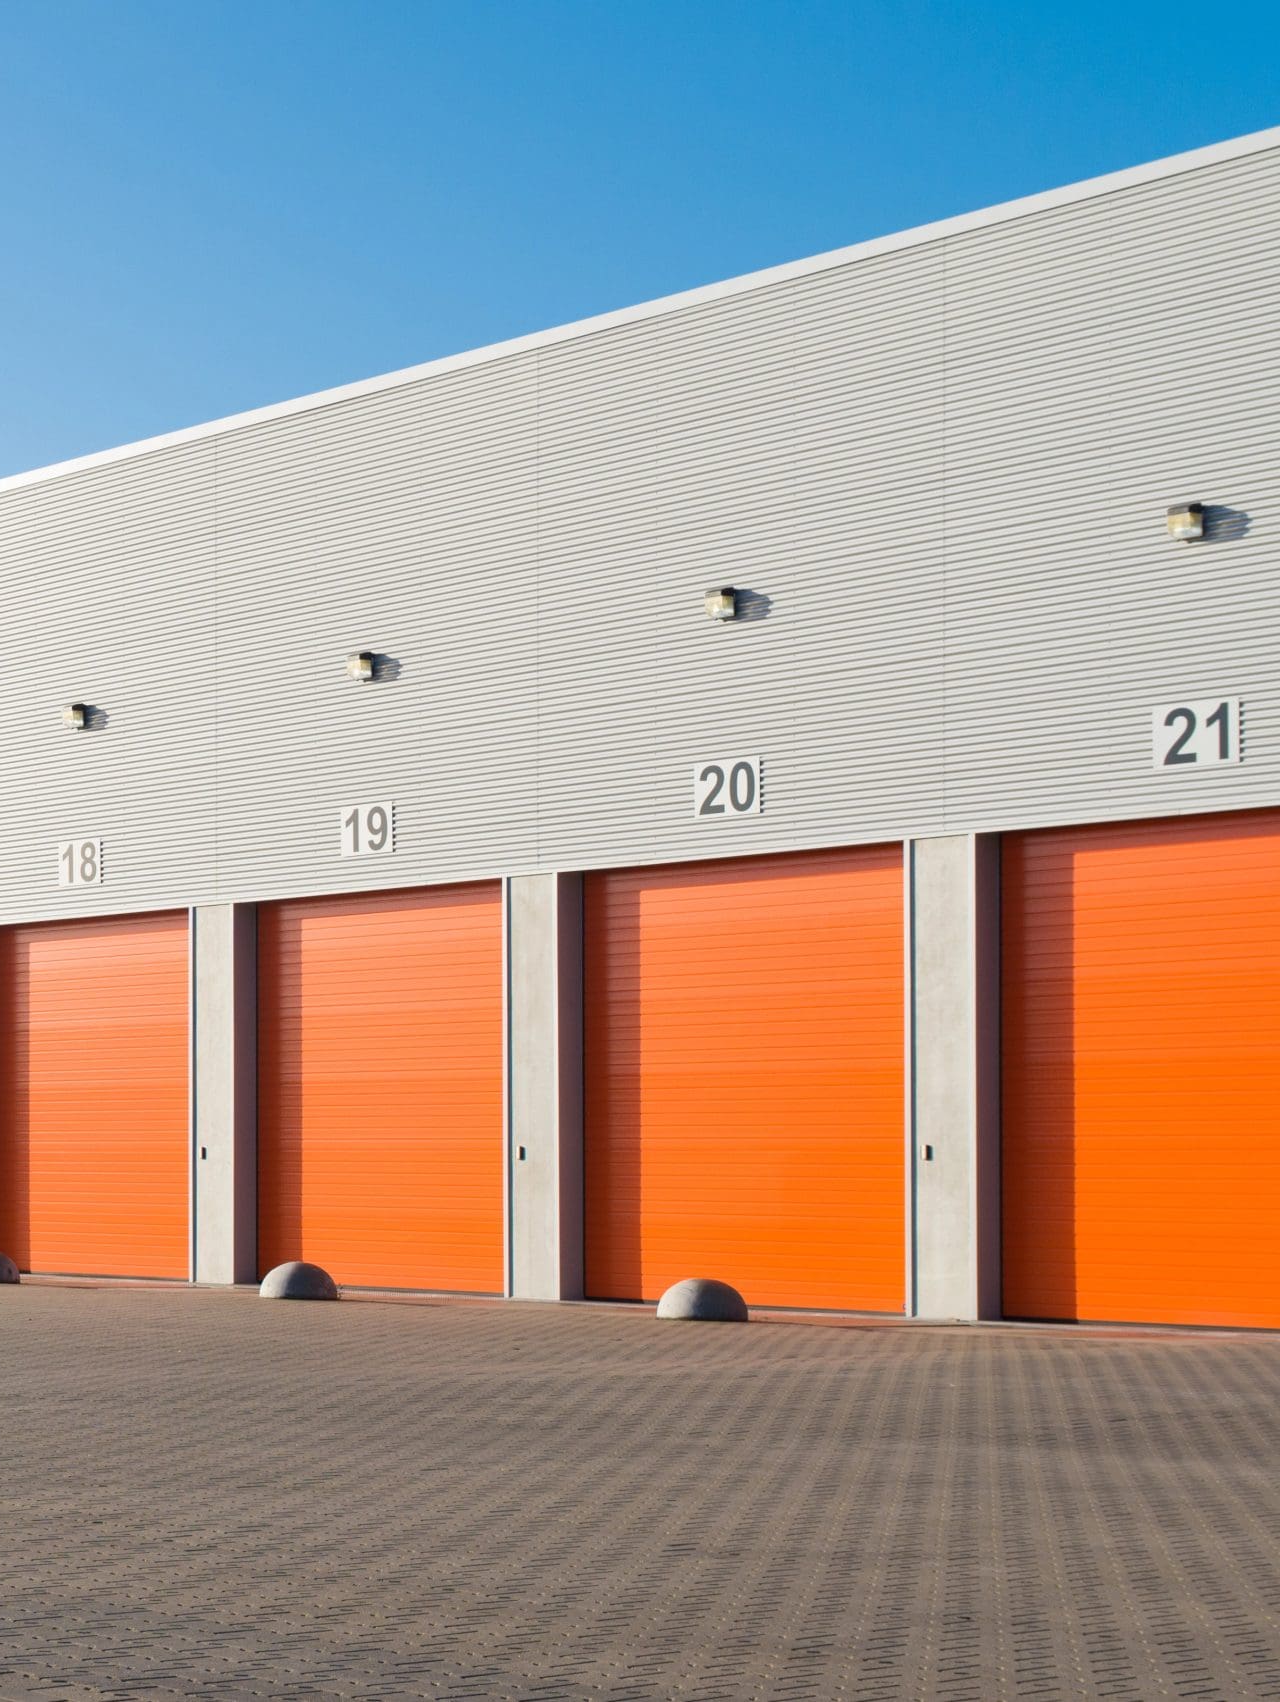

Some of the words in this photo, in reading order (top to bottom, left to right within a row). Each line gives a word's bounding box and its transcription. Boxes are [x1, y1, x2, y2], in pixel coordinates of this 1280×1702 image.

[1164, 702, 1229, 764] 21
[700, 761, 755, 815] 20
[345, 806, 388, 851] 19
[62, 842, 96, 884] 18
